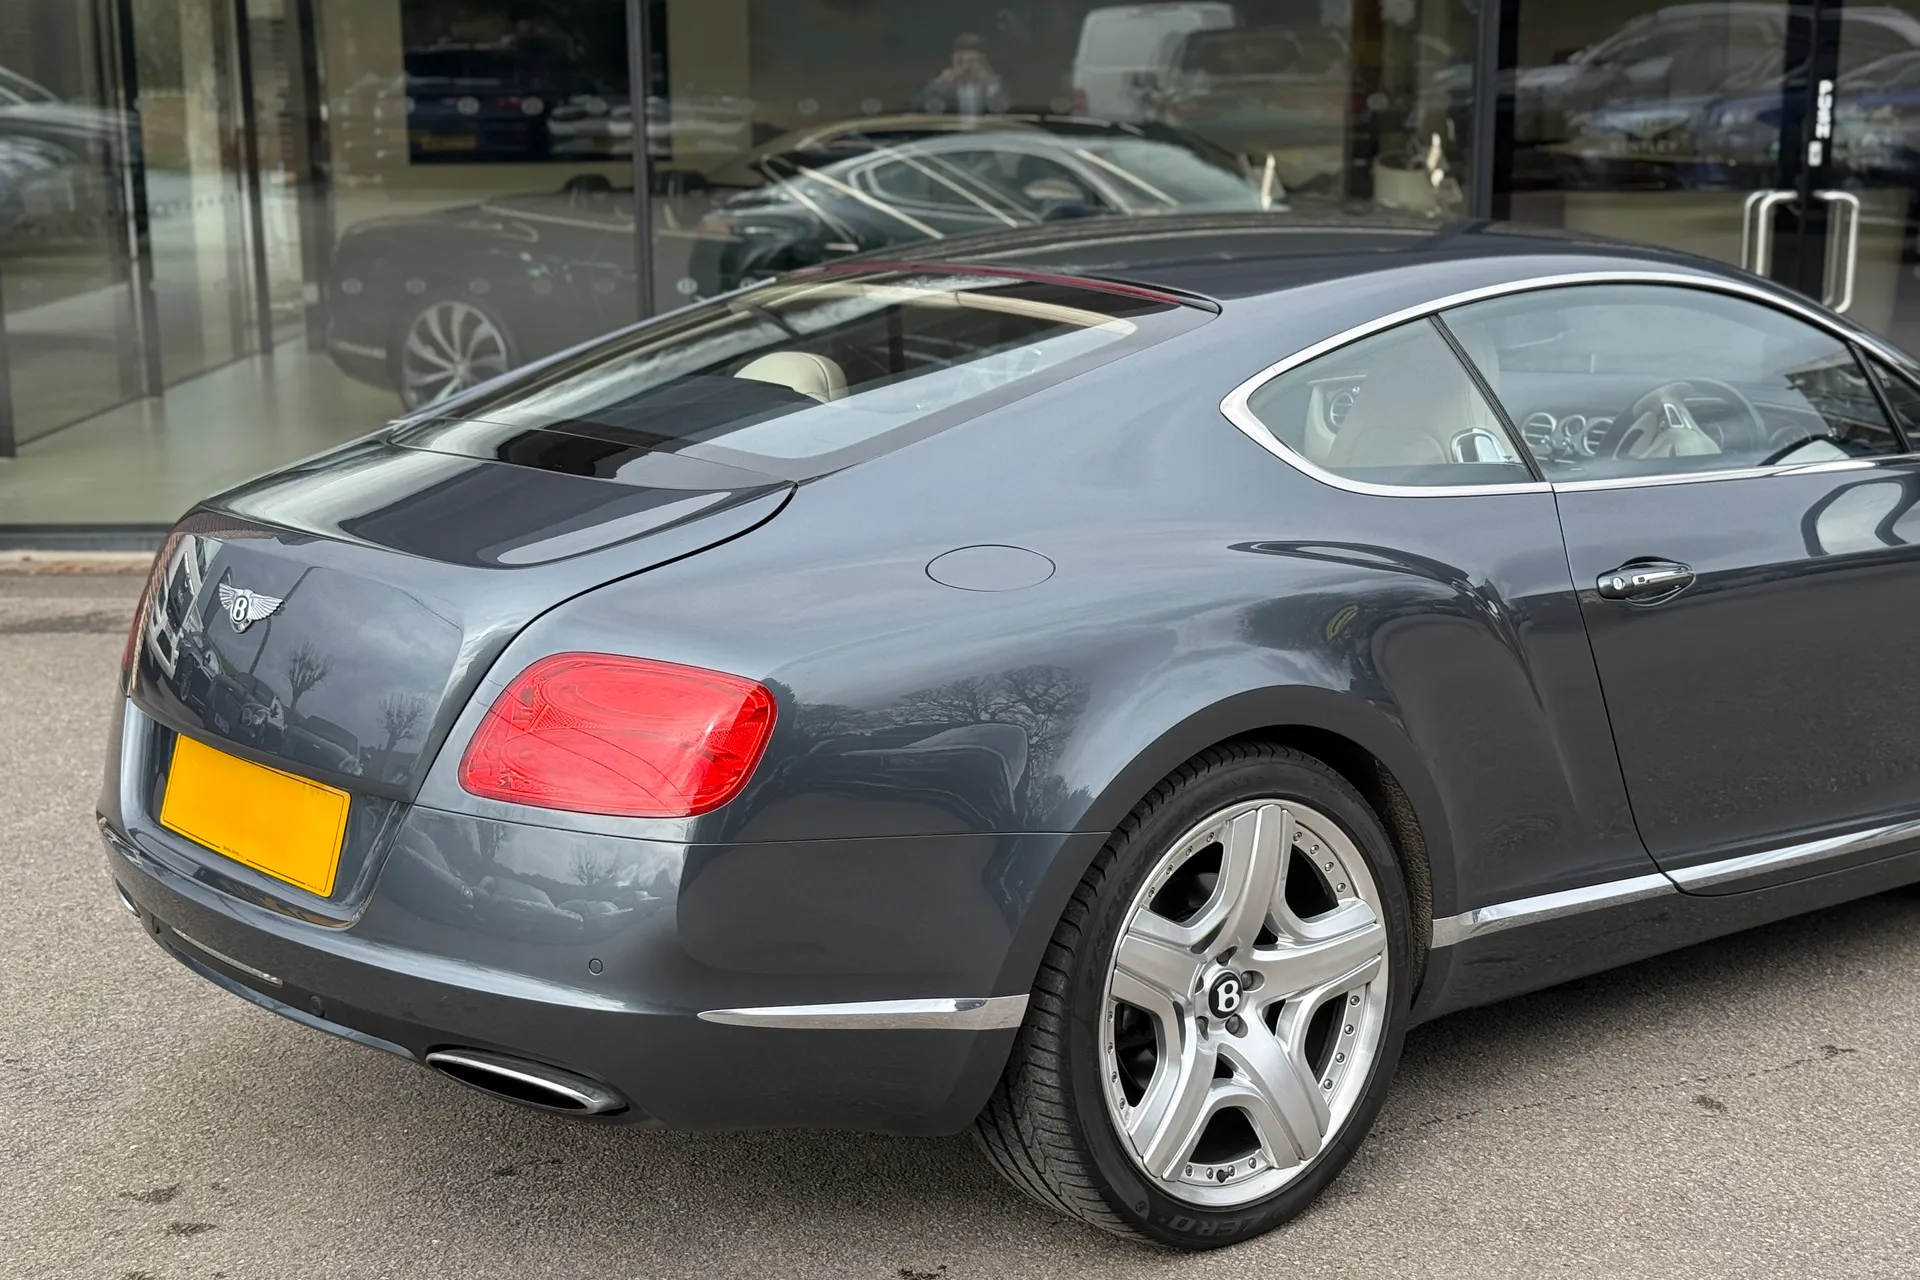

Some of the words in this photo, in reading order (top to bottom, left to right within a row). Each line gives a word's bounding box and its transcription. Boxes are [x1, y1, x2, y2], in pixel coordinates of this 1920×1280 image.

[1816, 80, 1833, 139] PUSH
[233, 596, 248, 621] B
[1217, 980, 1240, 1012] B
[1167, 1211, 1267, 1236] ZERO
